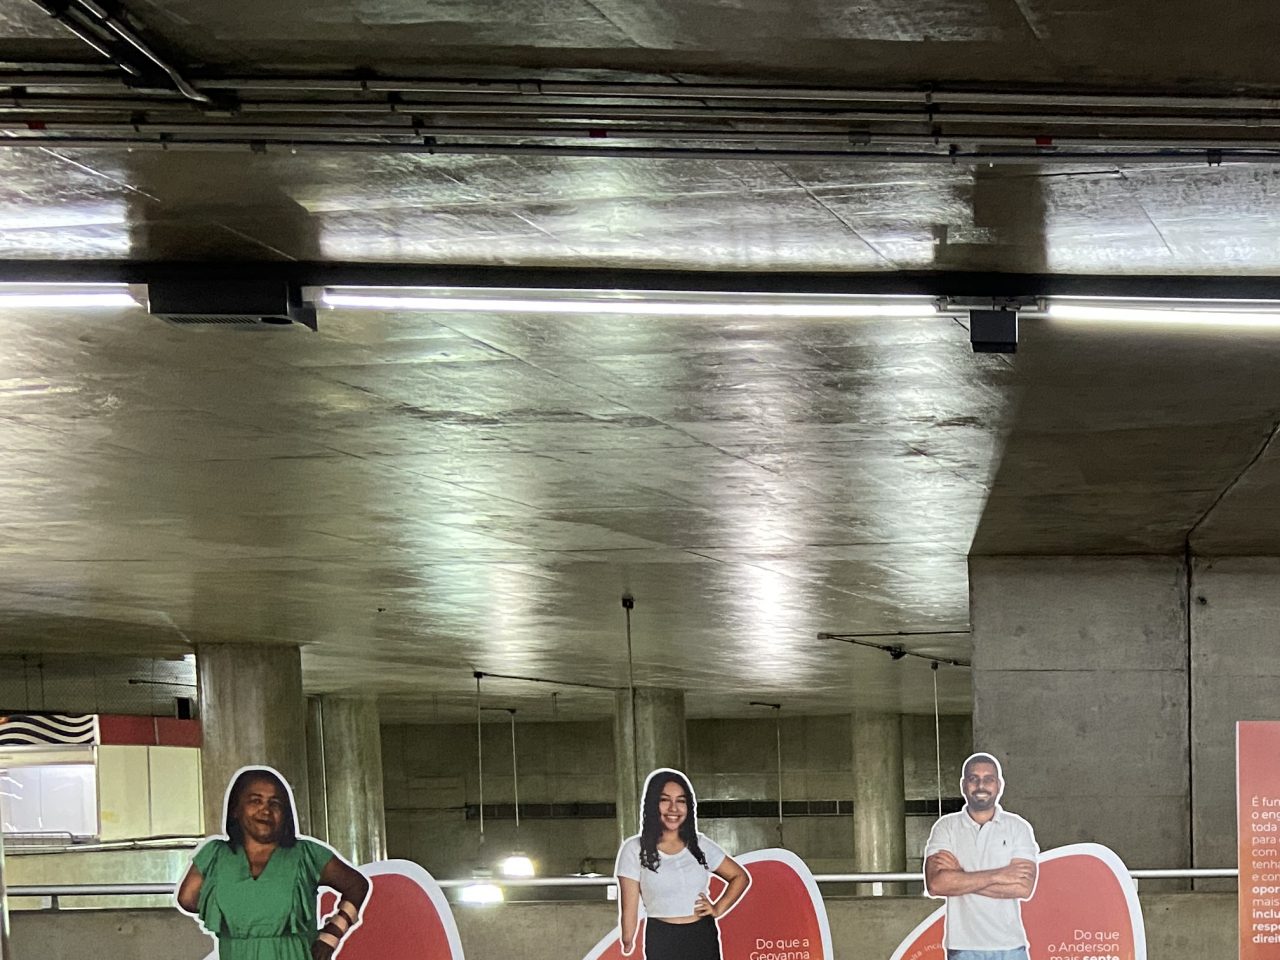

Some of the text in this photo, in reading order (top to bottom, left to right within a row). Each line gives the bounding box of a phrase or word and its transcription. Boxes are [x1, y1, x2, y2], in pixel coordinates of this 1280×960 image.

[1252, 794, 1260, 806] É
[1252, 812, 1259, 820] o
[1252, 822, 1278, 832] toda
[1252, 836, 1276, 846] para
[1252, 848, 1277, 856] com
[1252, 898, 1280, 906] mais
[1074, 930, 1120, 942] Do que
[756, 938, 810, 950] Do que a
[1048, 942, 1120, 952] o Anderson
